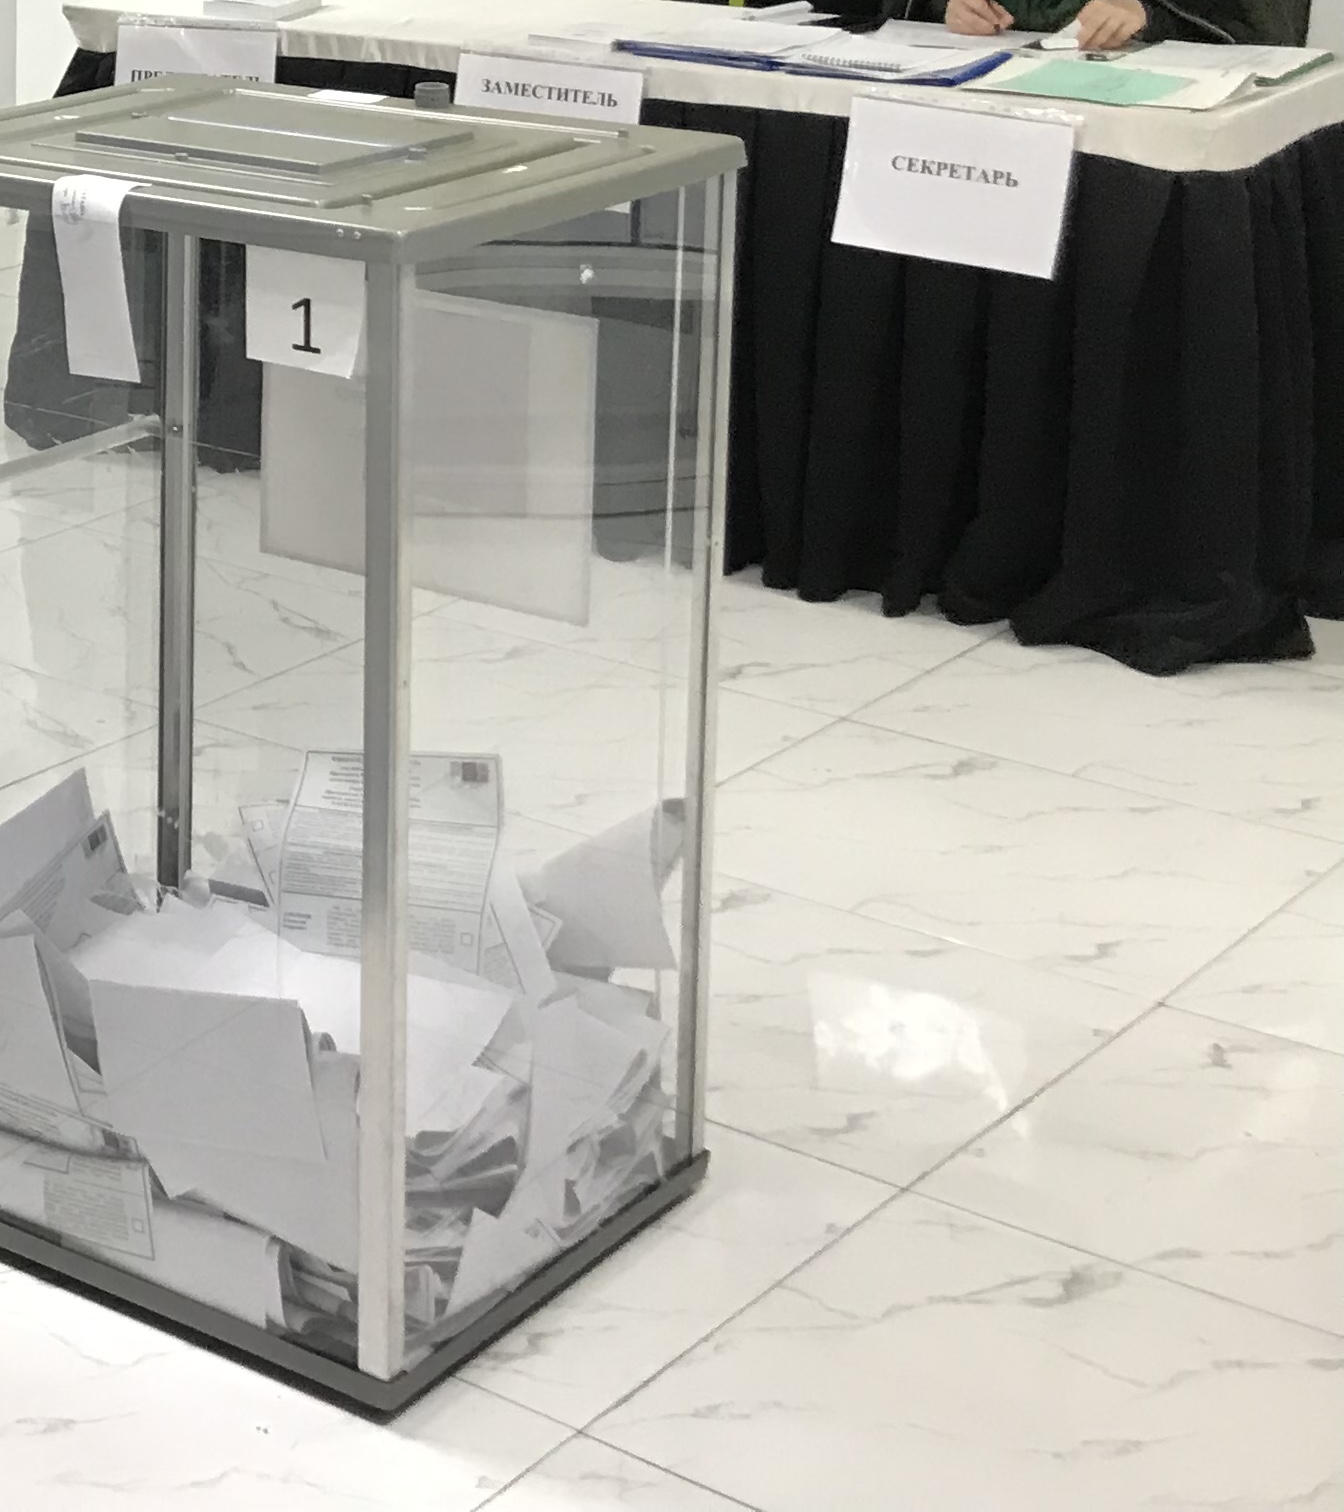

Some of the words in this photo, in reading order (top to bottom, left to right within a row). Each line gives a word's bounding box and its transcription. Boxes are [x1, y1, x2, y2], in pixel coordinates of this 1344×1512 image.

[481, 78, 618, 108] ЗАМЕСТИТЕЛЬ
[891, 155, 1019, 188] СЕКРЕТАРЬ
[292, 297, 322, 355] 1
